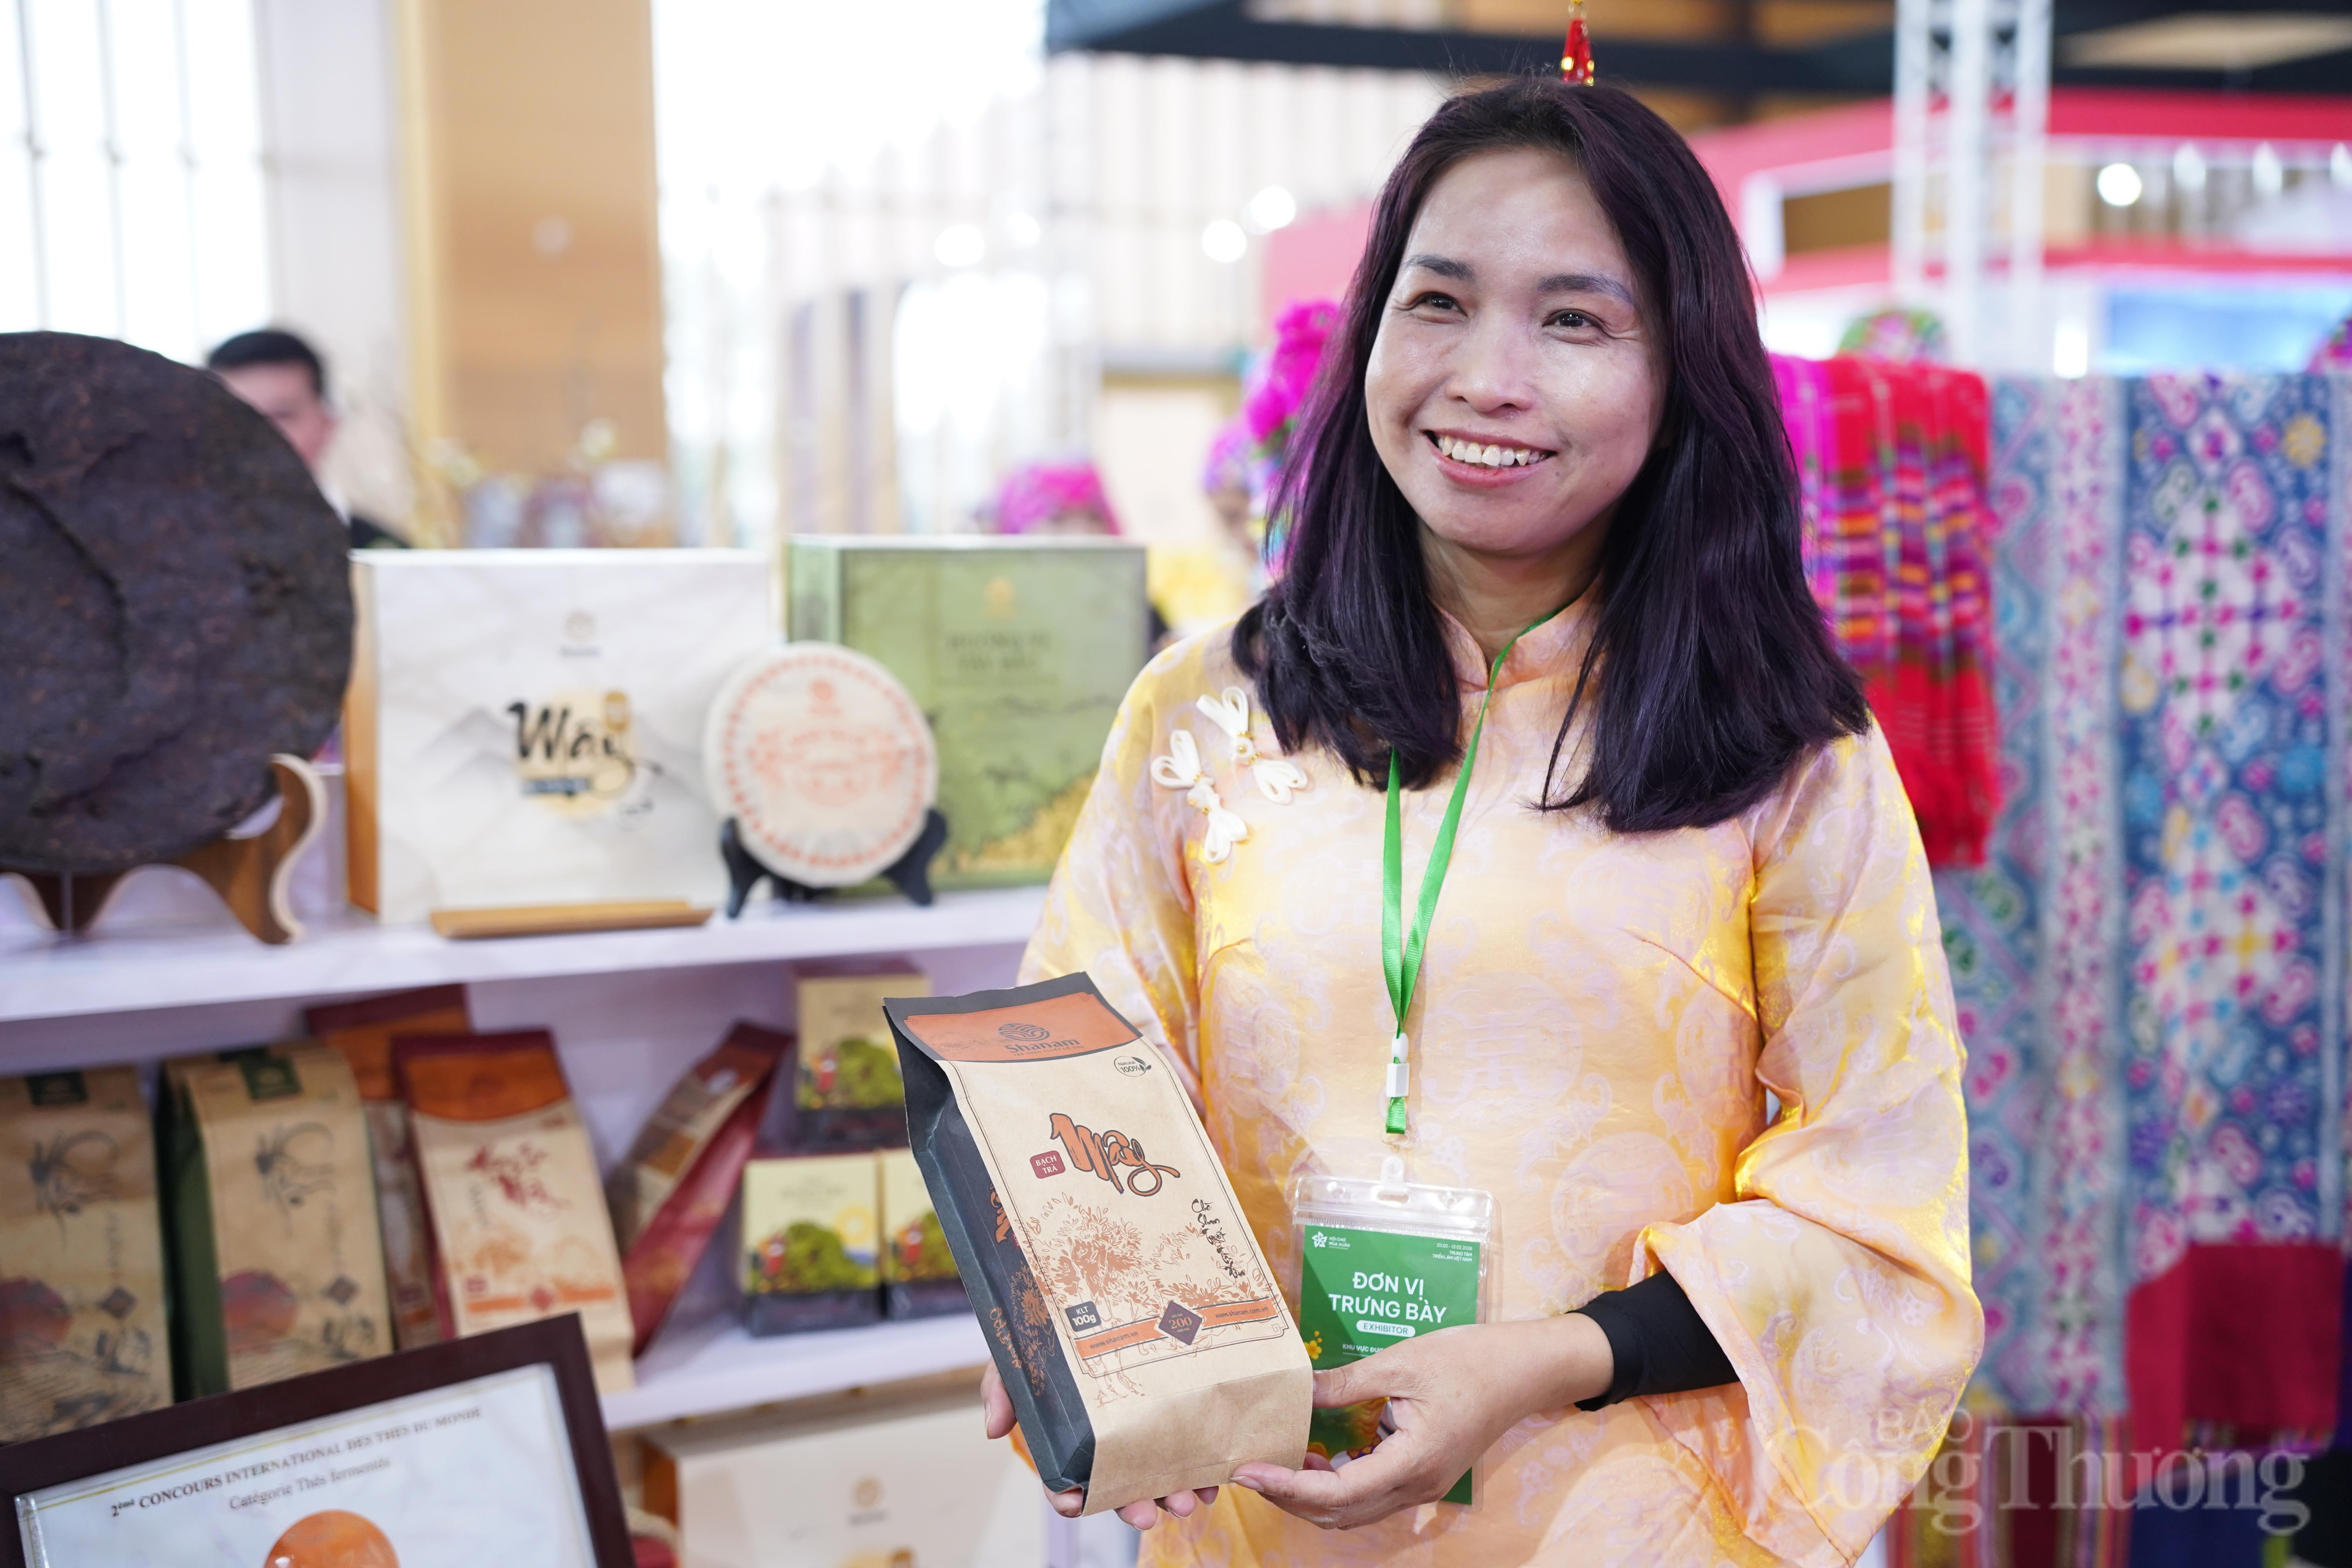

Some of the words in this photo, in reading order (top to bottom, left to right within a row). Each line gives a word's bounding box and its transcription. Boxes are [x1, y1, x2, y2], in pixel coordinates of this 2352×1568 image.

[1005, 1040, 1080, 1053] Shanam
[1035, 1155, 1057, 1167] BẠCH
[1042, 1164, 1058, 1174] TRÀ
[1352, 1272, 1399, 1293] ĐƠN
[1405, 1277, 1424, 1301] VỊ
[1076, 1306, 1088, 1315] KLT
[1215, 1307, 1269, 1319] www.shanam.com.vn
[1328, 1294, 1400, 1318] TRƯNG
[1406, 1299, 1446, 1323] BÀY
[1072, 1313, 1097, 1327] 100g
[1168, 1316, 1192, 1329] 200
[1364, 1323, 1408, 1334] EXHIBITOR
[1089, 1331, 1139, 1349] www.shanam.vn
[139, 1474, 223, 1509] CONCOURS
[225, 1443, 343, 1484] INTERNATIONAL
[346, 1435, 372, 1451] DES
[229, 1484, 293, 1510] Catégorie
